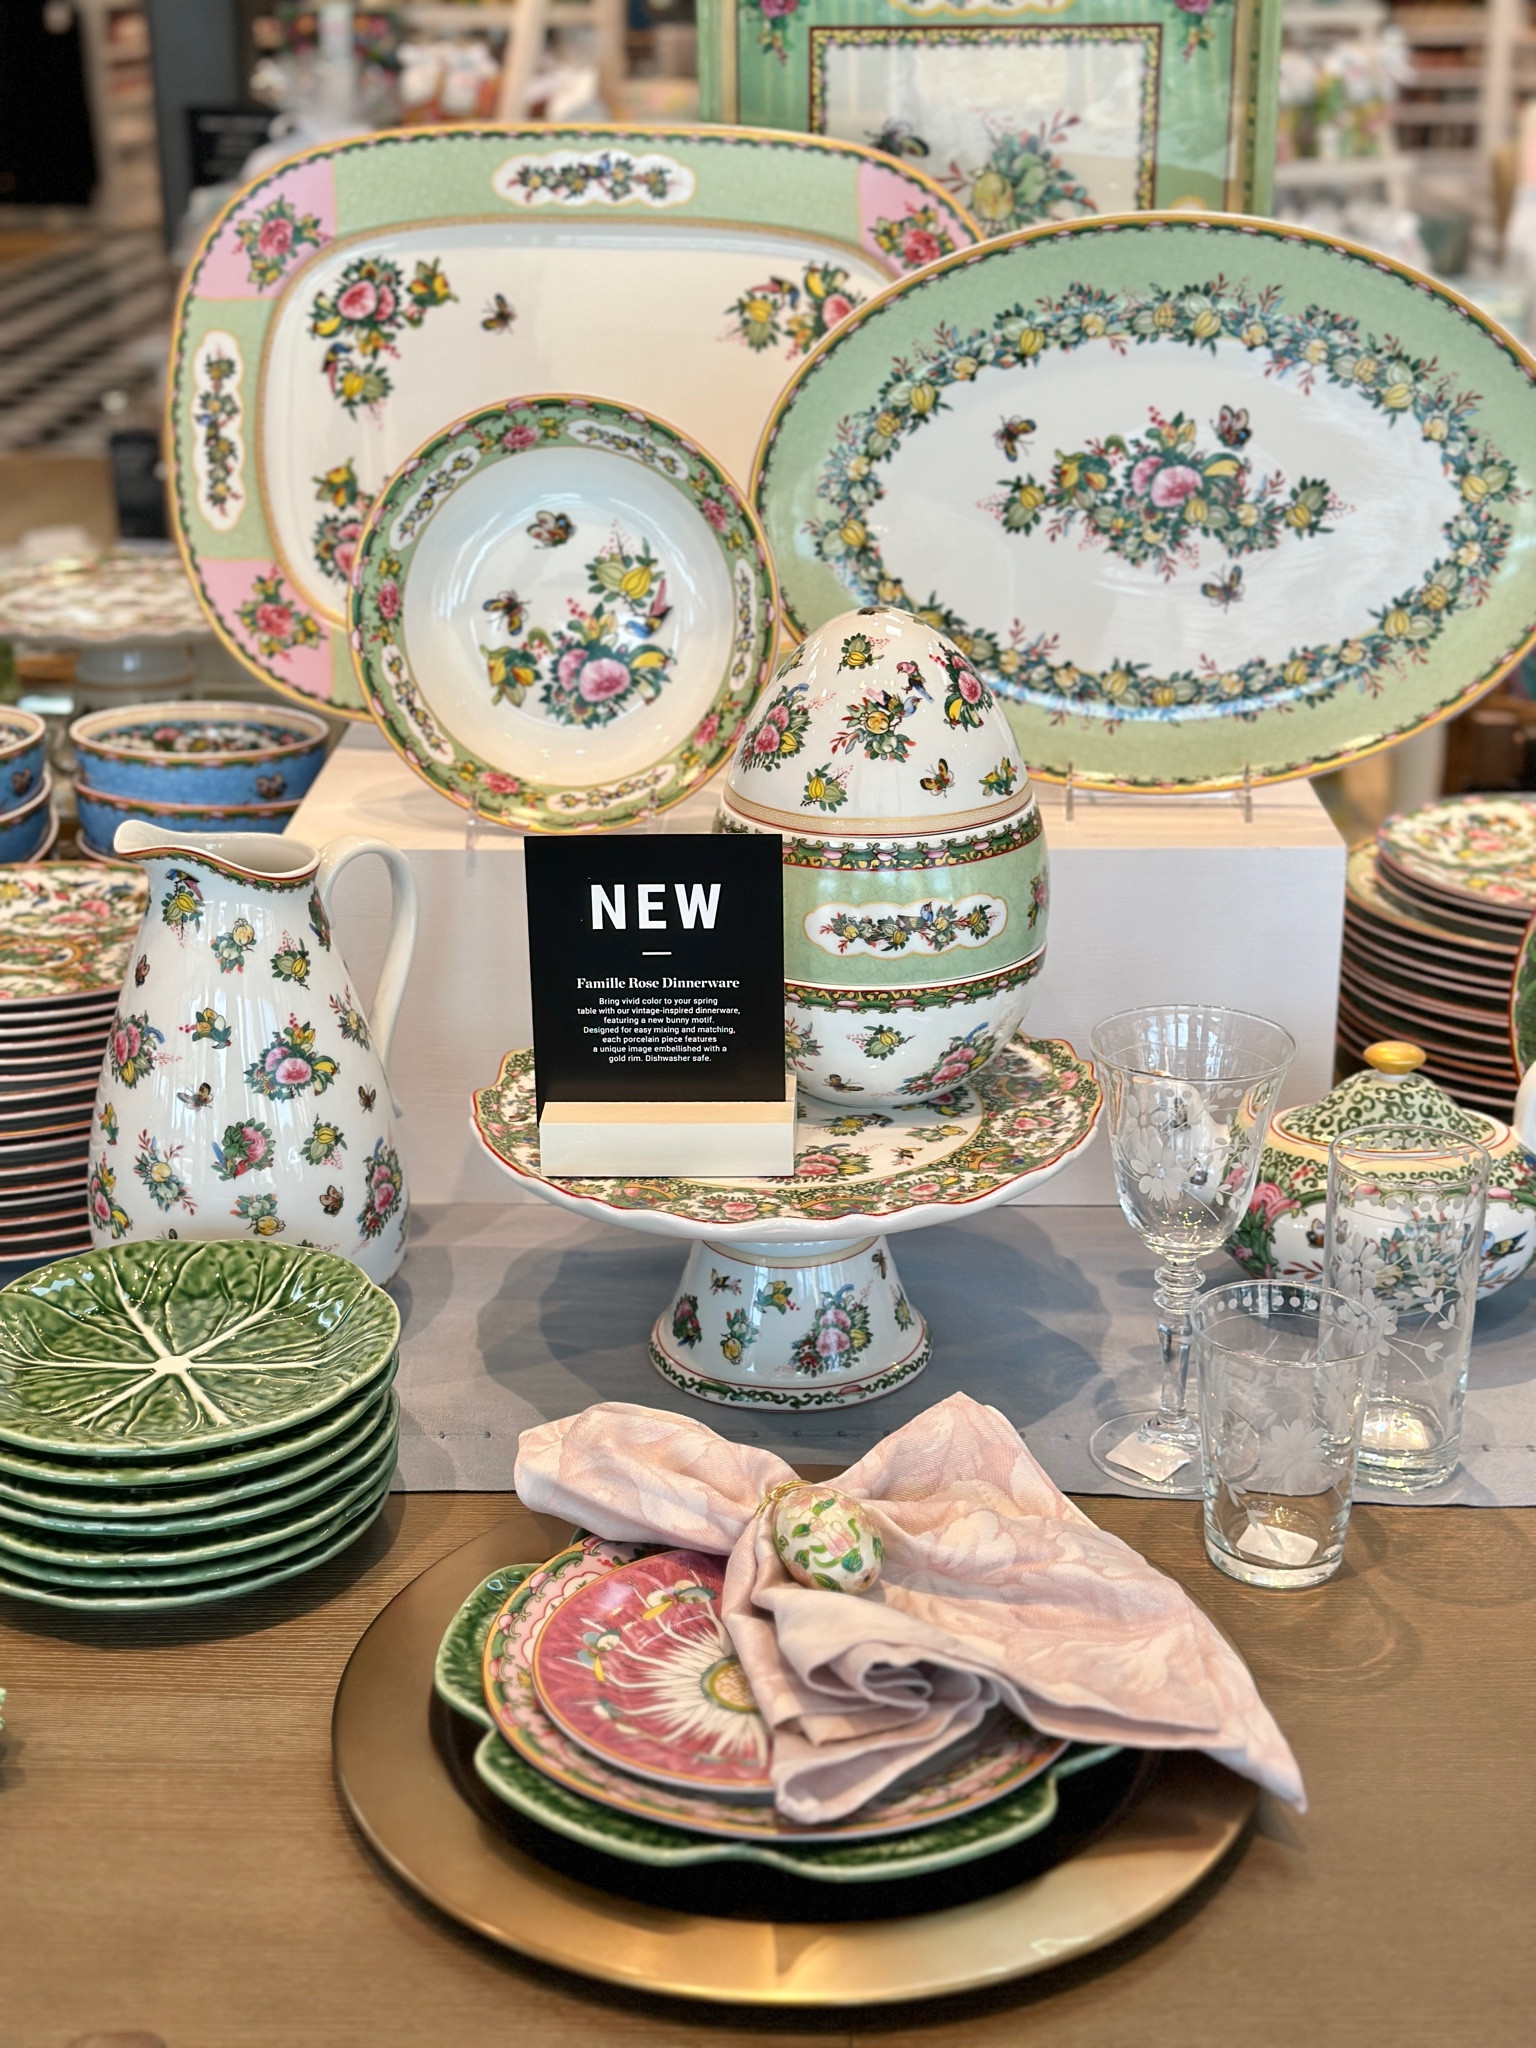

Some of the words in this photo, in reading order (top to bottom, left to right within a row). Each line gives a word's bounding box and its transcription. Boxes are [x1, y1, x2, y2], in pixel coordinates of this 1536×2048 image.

[590, 884, 721, 930] NEW
[576, 977, 626, 989] Famille
[628, 977, 660, 989] Rose
[662, 977, 740, 989] Dinnerware
[599, 997, 620, 1006] Bring
[621, 997, 640, 1005] vivid
[641, 997, 662, 1005] color
[693, 997, 718, 1006] spring
[631, 1007, 694, 1015] vintage-inspired
[695, 1007, 741, 1015] dinnerware,
[603, 1016, 639, 1025] featuring
[665, 1016, 690, 1025] bunny
[691, 1016, 715, 1024] motif.
[583, 1027, 620, 1035] Designed
[633, 1027, 652, 1035] easy
[653, 1026, 680, 1035] mixing
[697, 1026, 736, 1035] matching,
[623, 1036, 660, 1044] porcelain
[661, 1036, 683, 1044] piece
[684, 1035, 718, 1043] features
[599, 1045, 626, 1053] unique
[627, 1045, 652, 1054] image
[608, 1055, 626, 1063] gold
[692, 1054, 712, 1062] safe.
